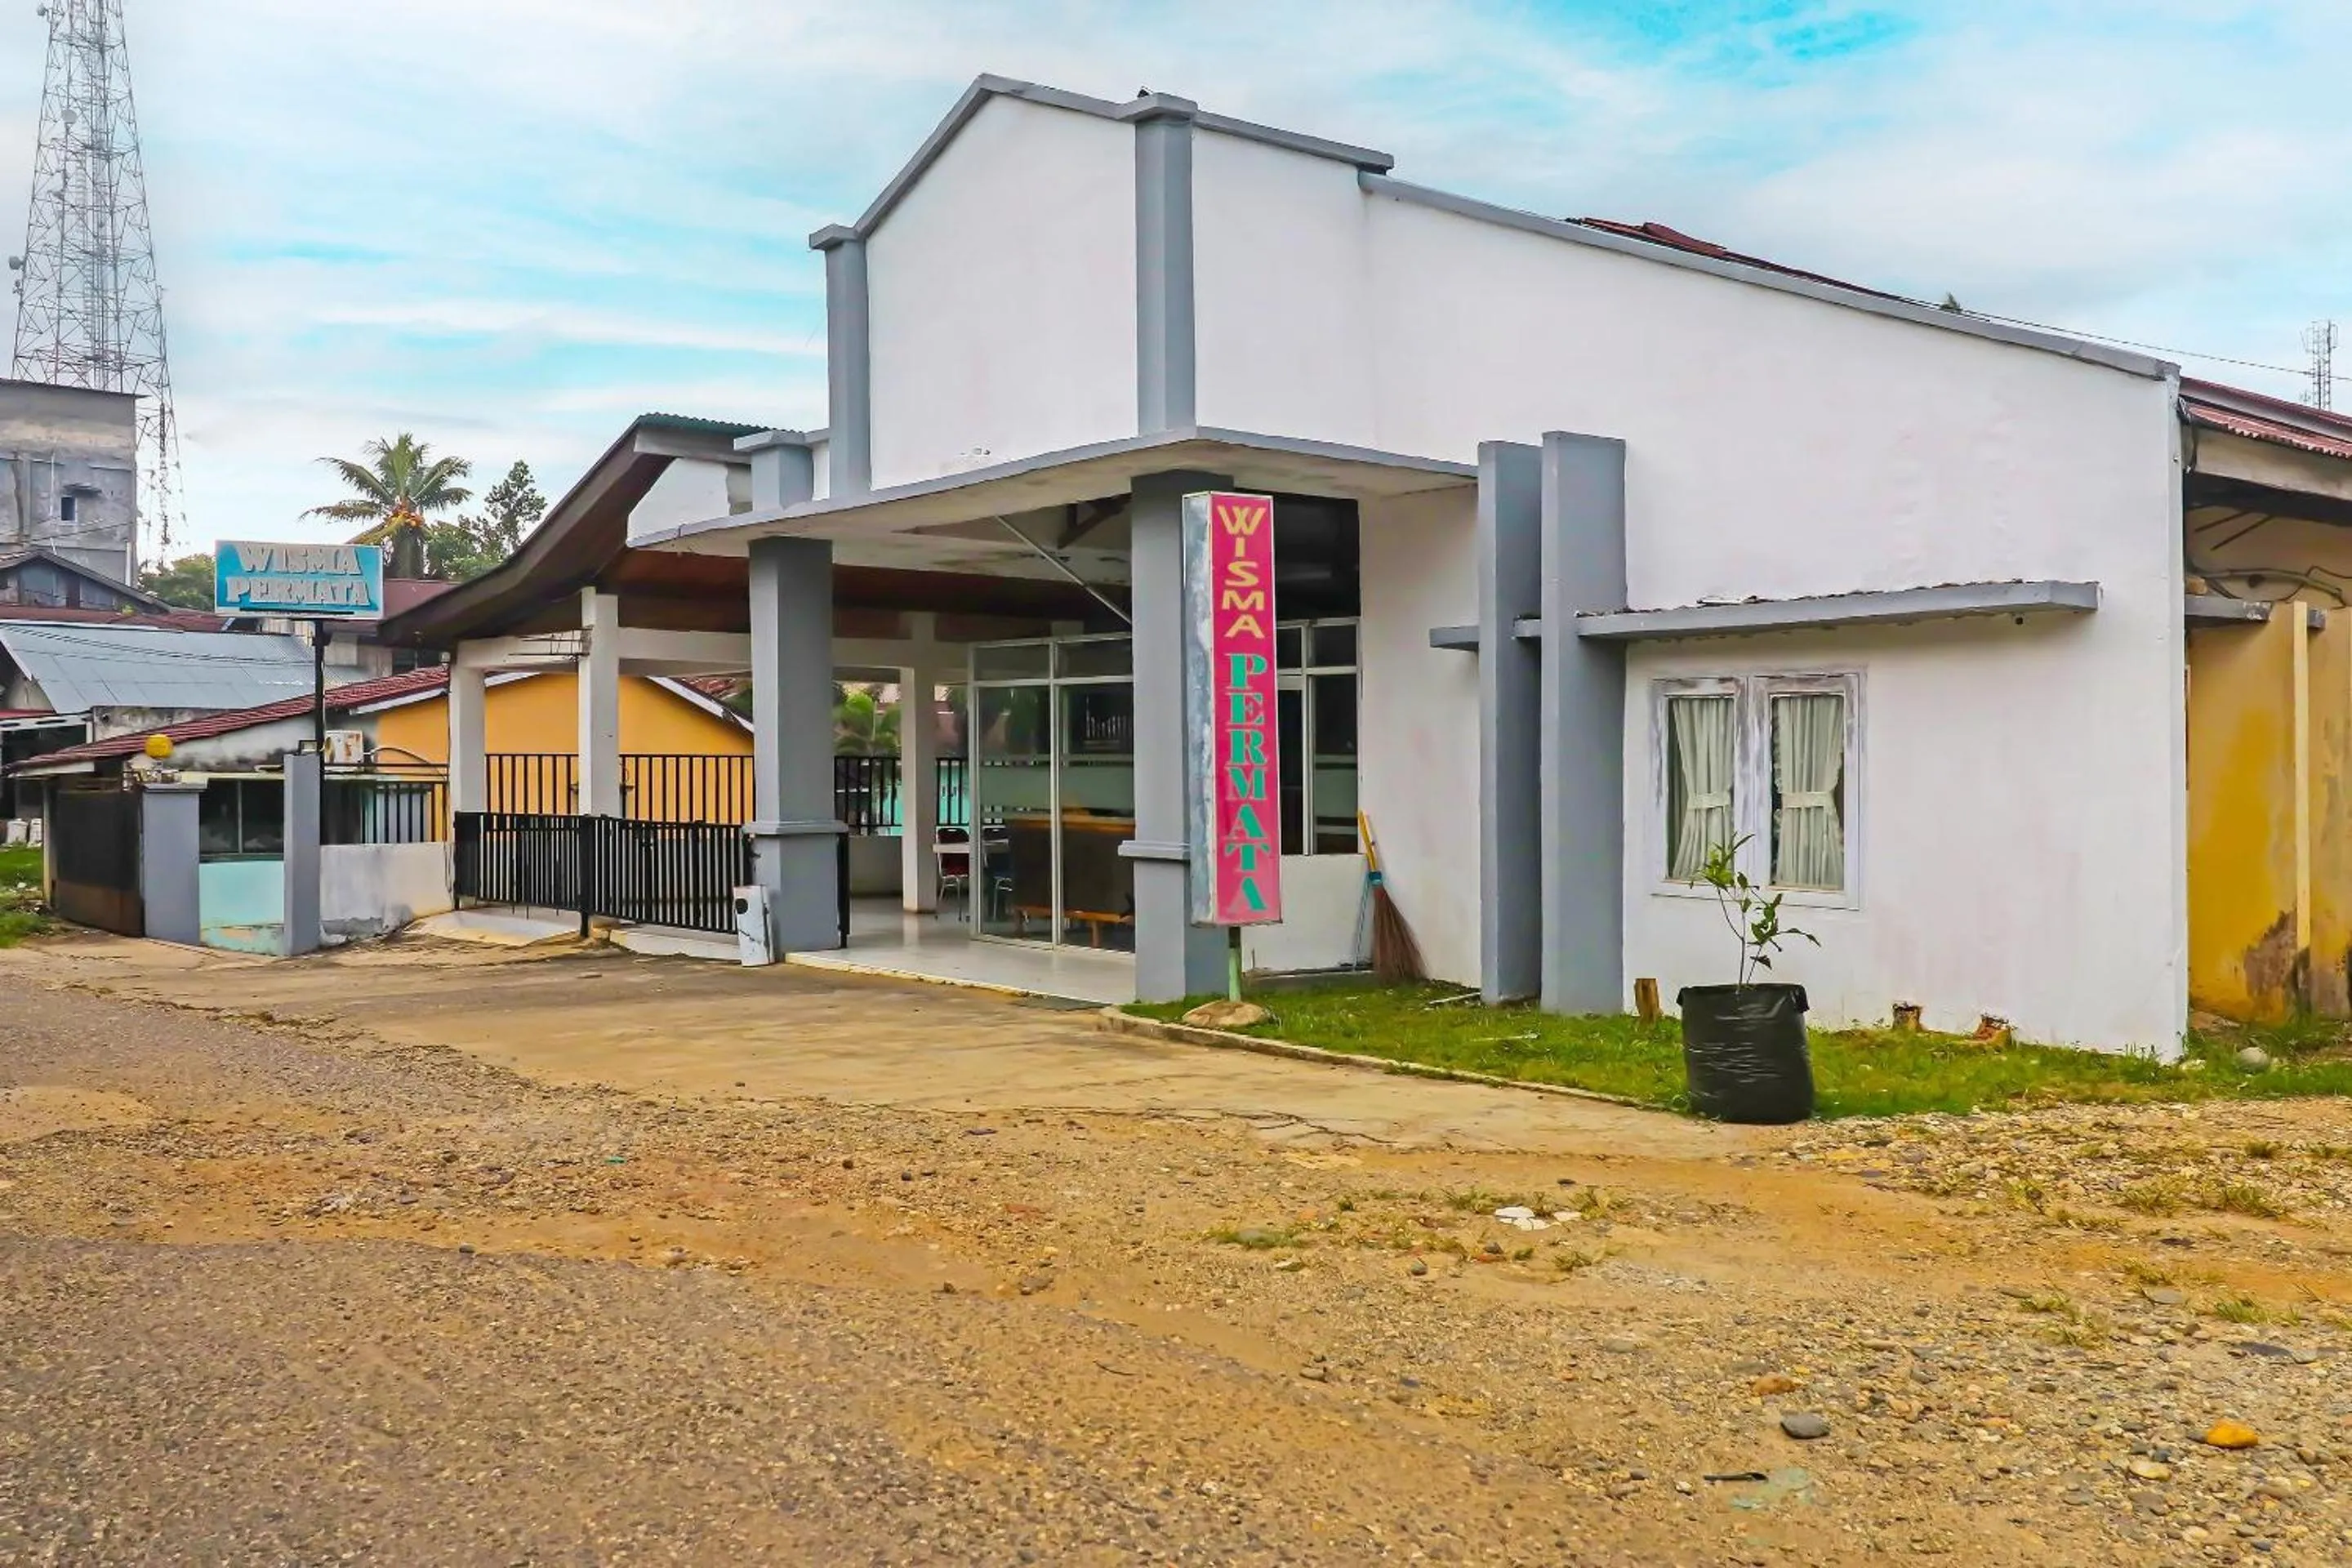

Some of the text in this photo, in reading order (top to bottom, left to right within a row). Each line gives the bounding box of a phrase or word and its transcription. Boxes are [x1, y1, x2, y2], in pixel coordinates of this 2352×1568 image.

[238, 546, 362, 574] WISMA
[226, 577, 370, 605] PERMATA
[1217, 505, 1270, 911] WISMA PERMATA
